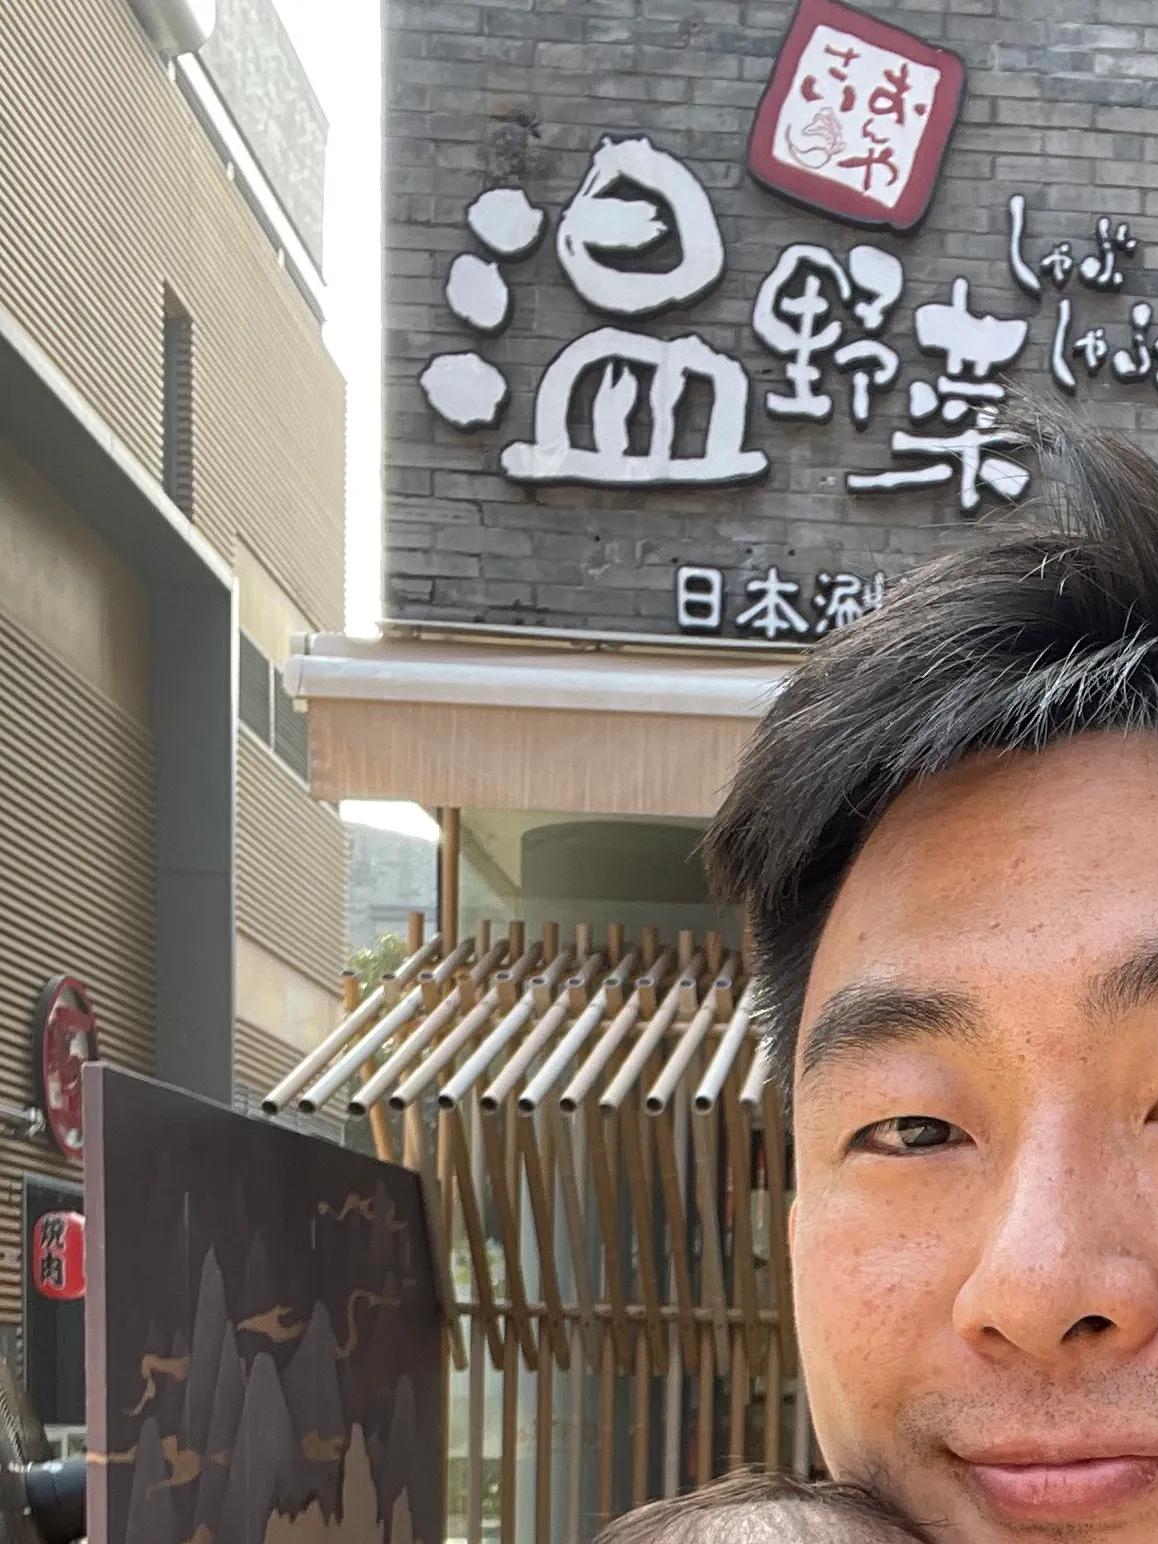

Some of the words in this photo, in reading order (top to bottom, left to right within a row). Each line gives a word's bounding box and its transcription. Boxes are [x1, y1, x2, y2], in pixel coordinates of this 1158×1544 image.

[417, 135, 1031, 509] 温野菜
[1008, 194, 1138, 291] しゃぶ
